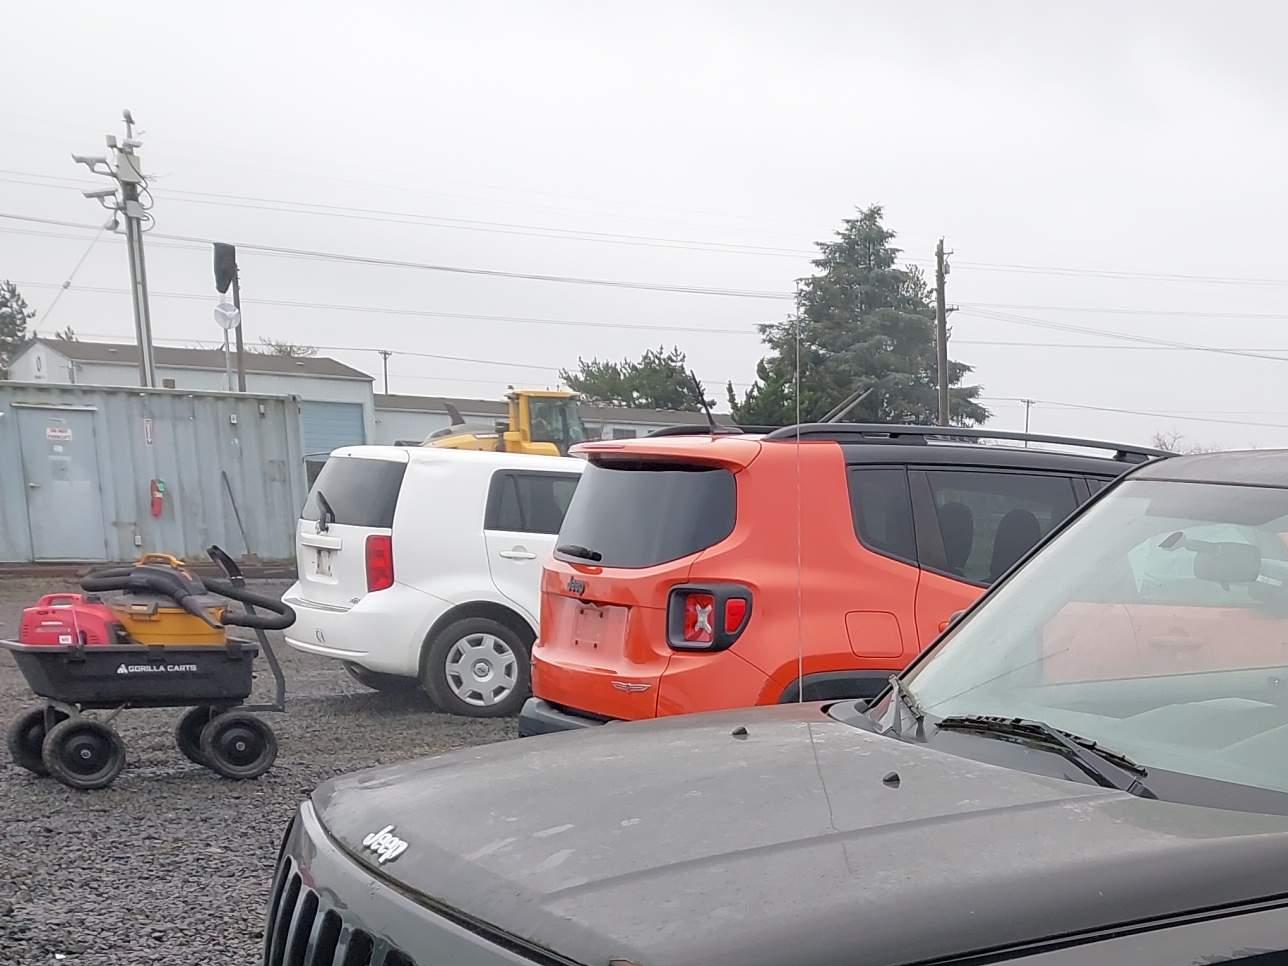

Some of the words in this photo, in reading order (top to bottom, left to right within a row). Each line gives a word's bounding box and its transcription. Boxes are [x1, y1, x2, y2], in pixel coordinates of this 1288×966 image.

[128, 664, 165, 672] GORILLA
[167, 664, 197, 672] CARTS
[363, 824, 409, 863] Jeep
